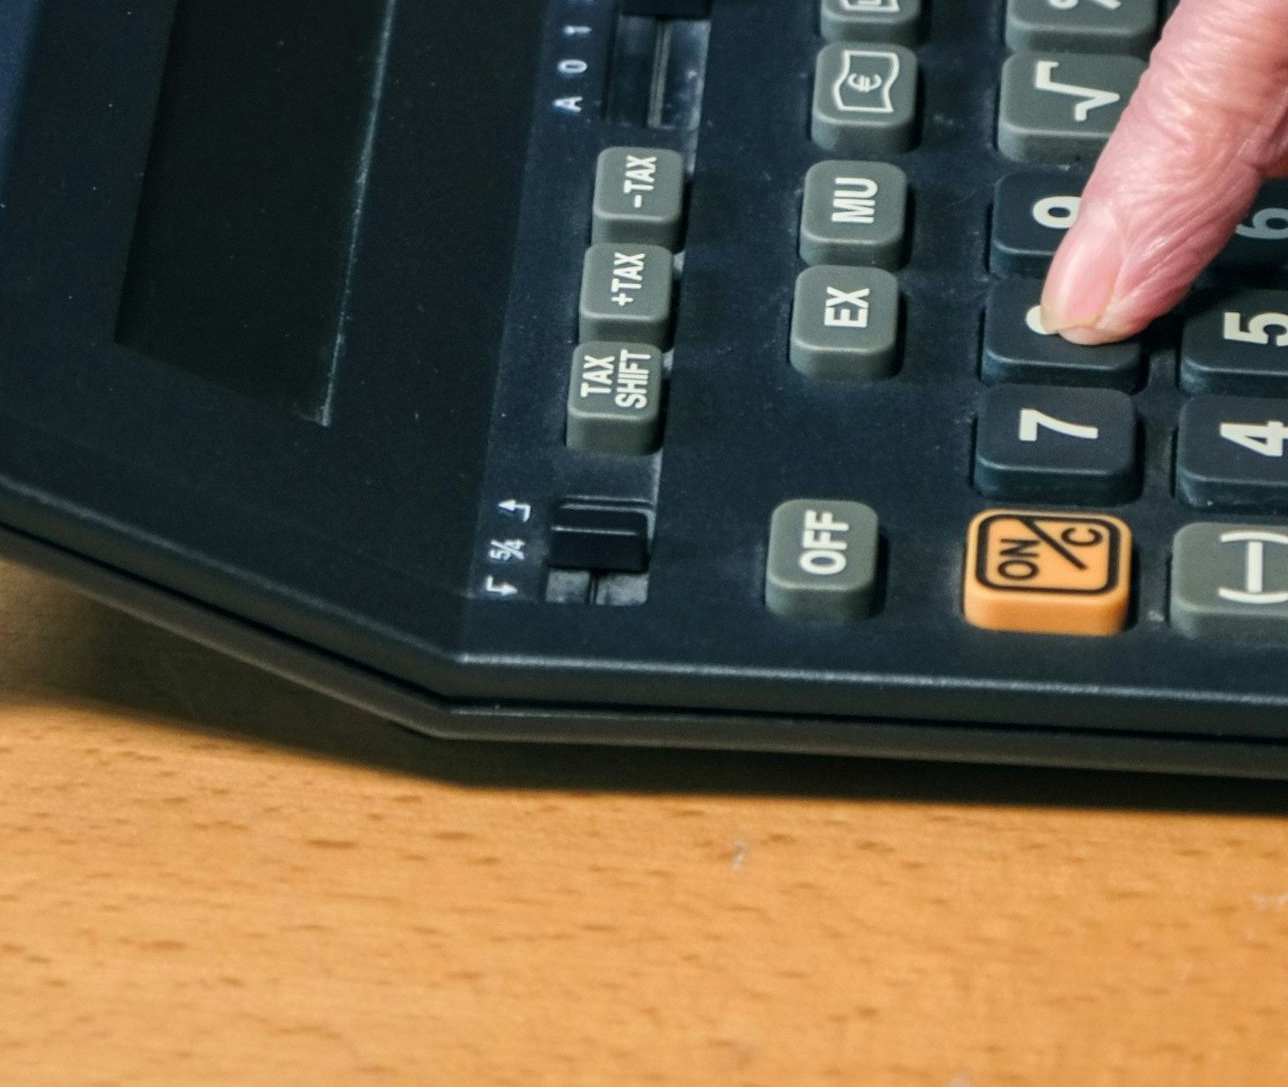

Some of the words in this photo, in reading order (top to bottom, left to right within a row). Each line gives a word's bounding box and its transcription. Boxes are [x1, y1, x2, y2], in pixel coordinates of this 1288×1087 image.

[562, 24, 593, 37] 1
[557, 58, 589, 76] 0
[847, 72, 883, 94] €
[553, 95, 584, 114] A
[831, 176, 879, 225] MU
[610, 251, 647, 308] +TAX
[823, 285, 871, 329] EX
[580, 355, 616, 398] TAX
[614, 348, 652, 410] SHIFT
[1018, 407, 1100, 442] 7
[799, 509, 850, 576] OFF
